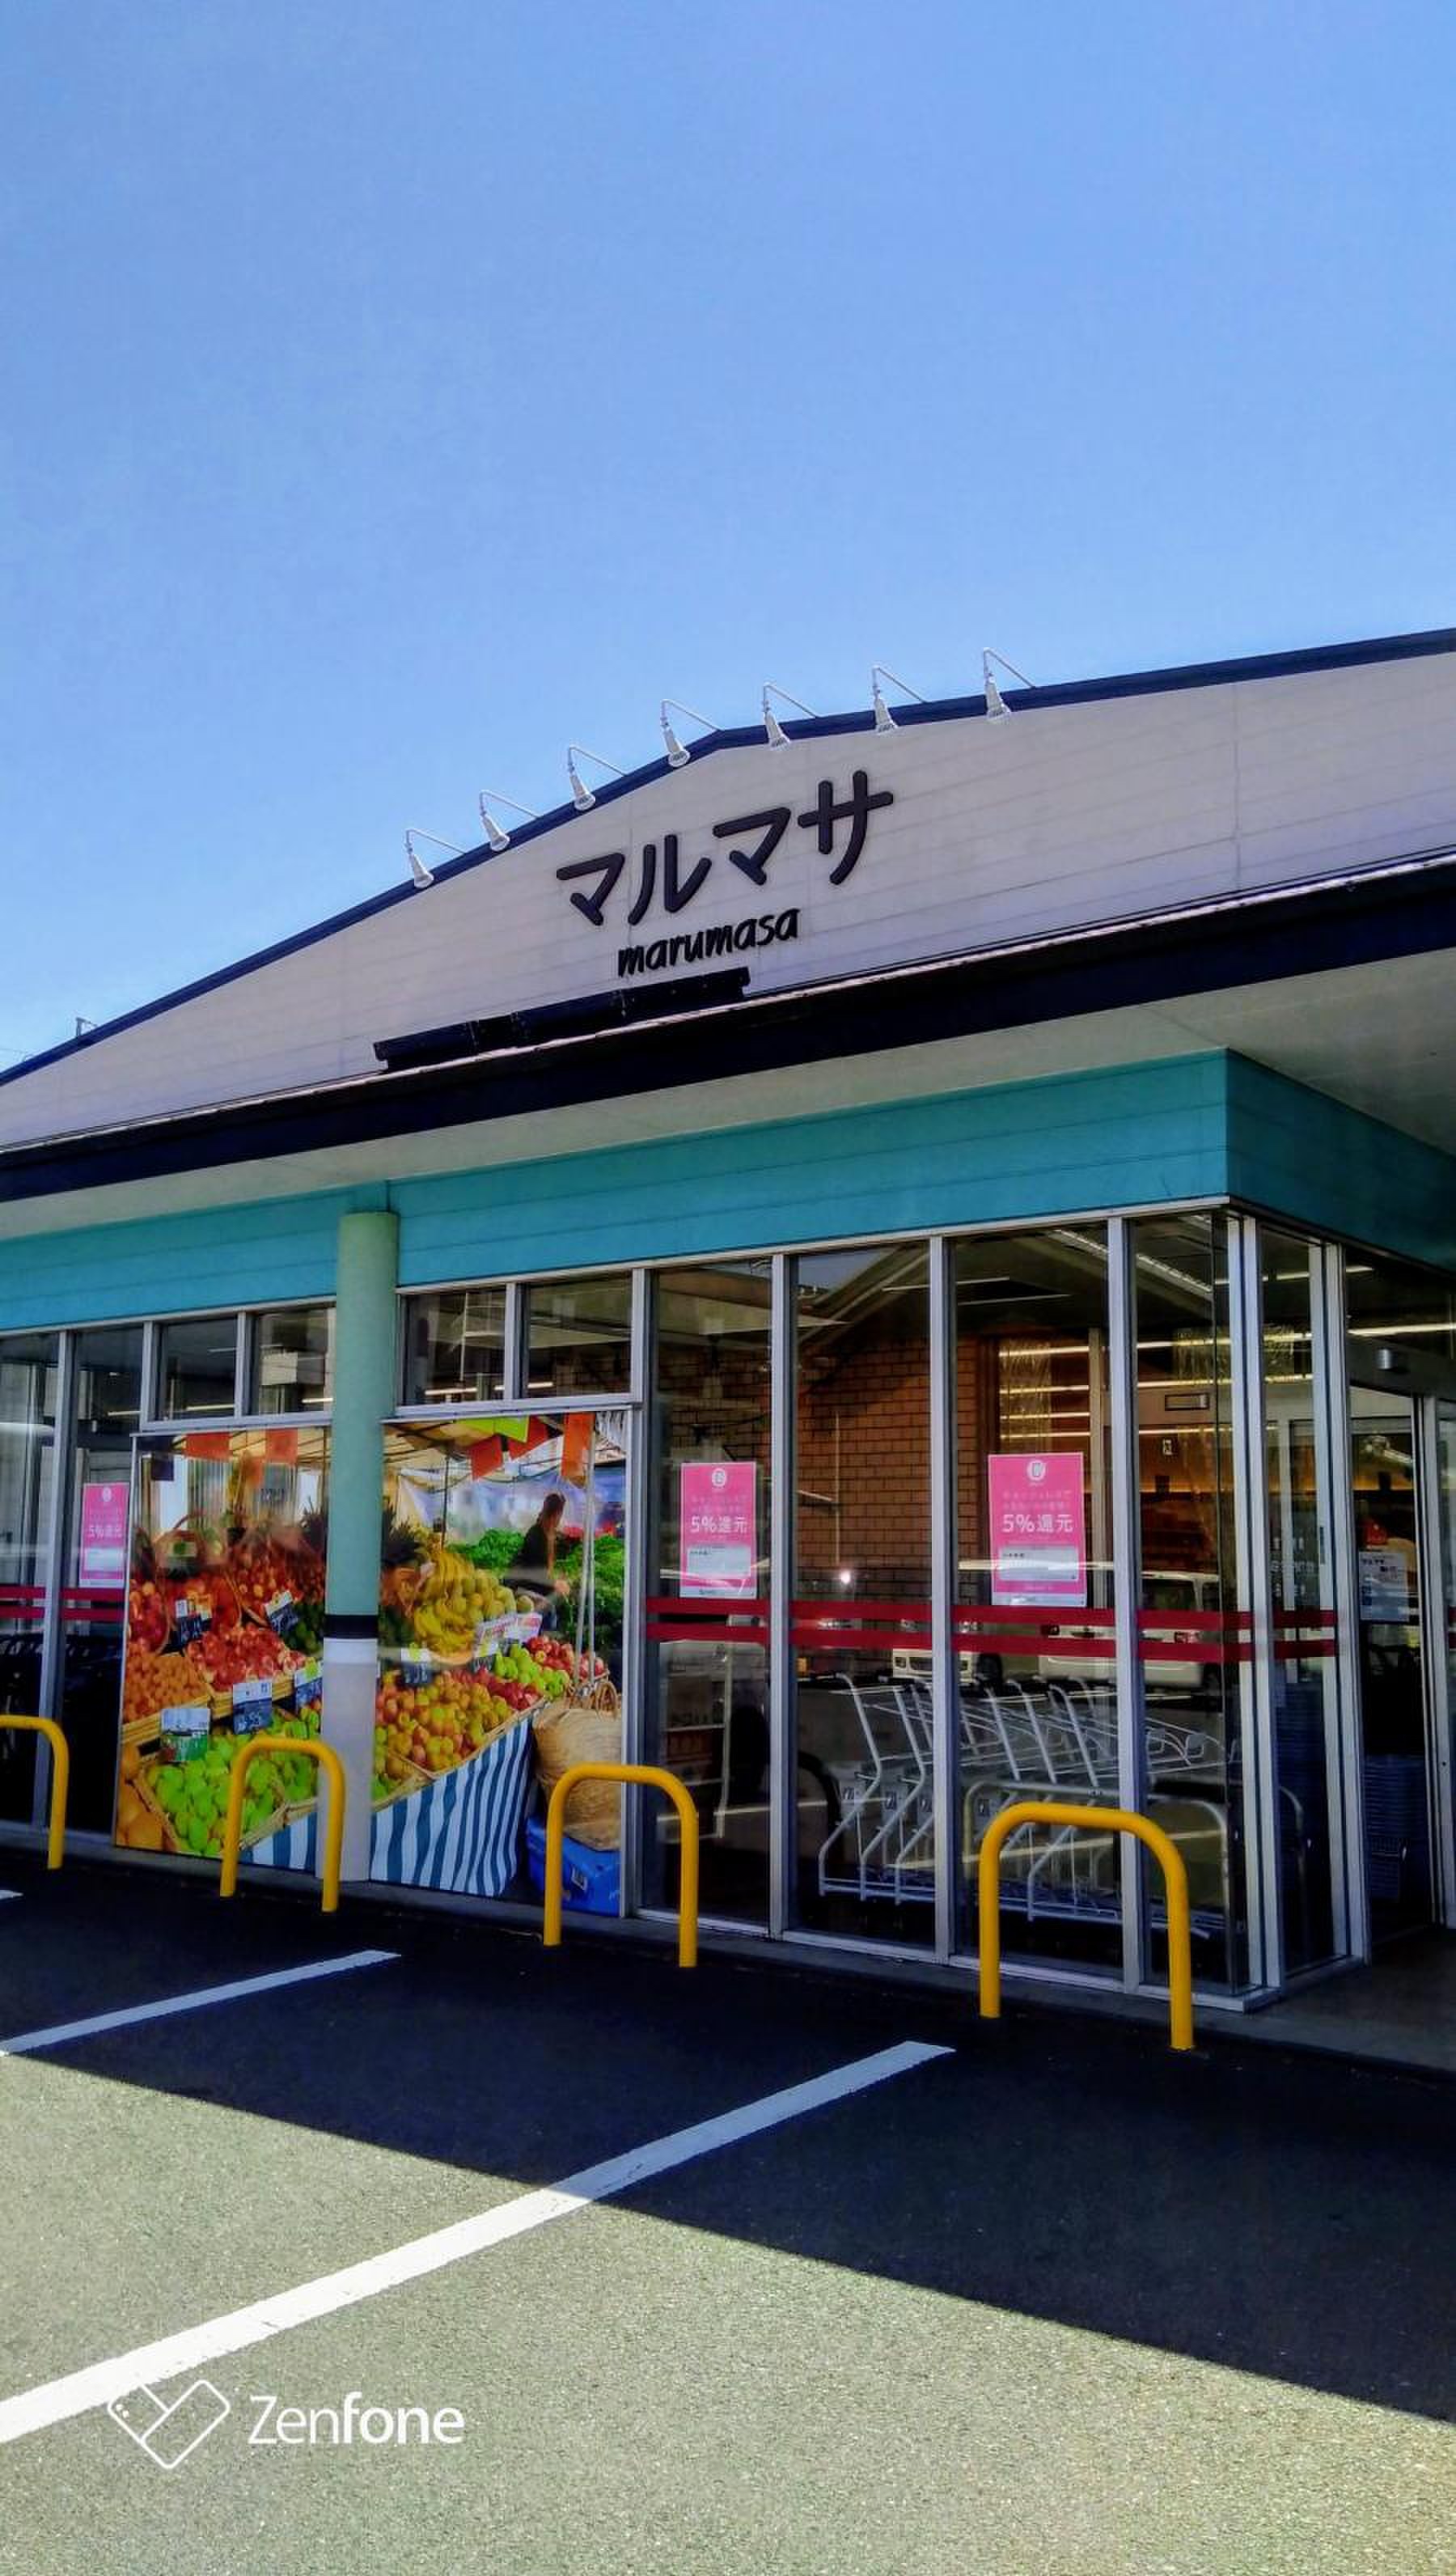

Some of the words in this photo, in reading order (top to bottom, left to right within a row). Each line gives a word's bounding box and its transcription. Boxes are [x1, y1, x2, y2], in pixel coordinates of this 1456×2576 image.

[556, 769, 894, 926] マルマサ
[617, 907, 801, 977] marumasa
